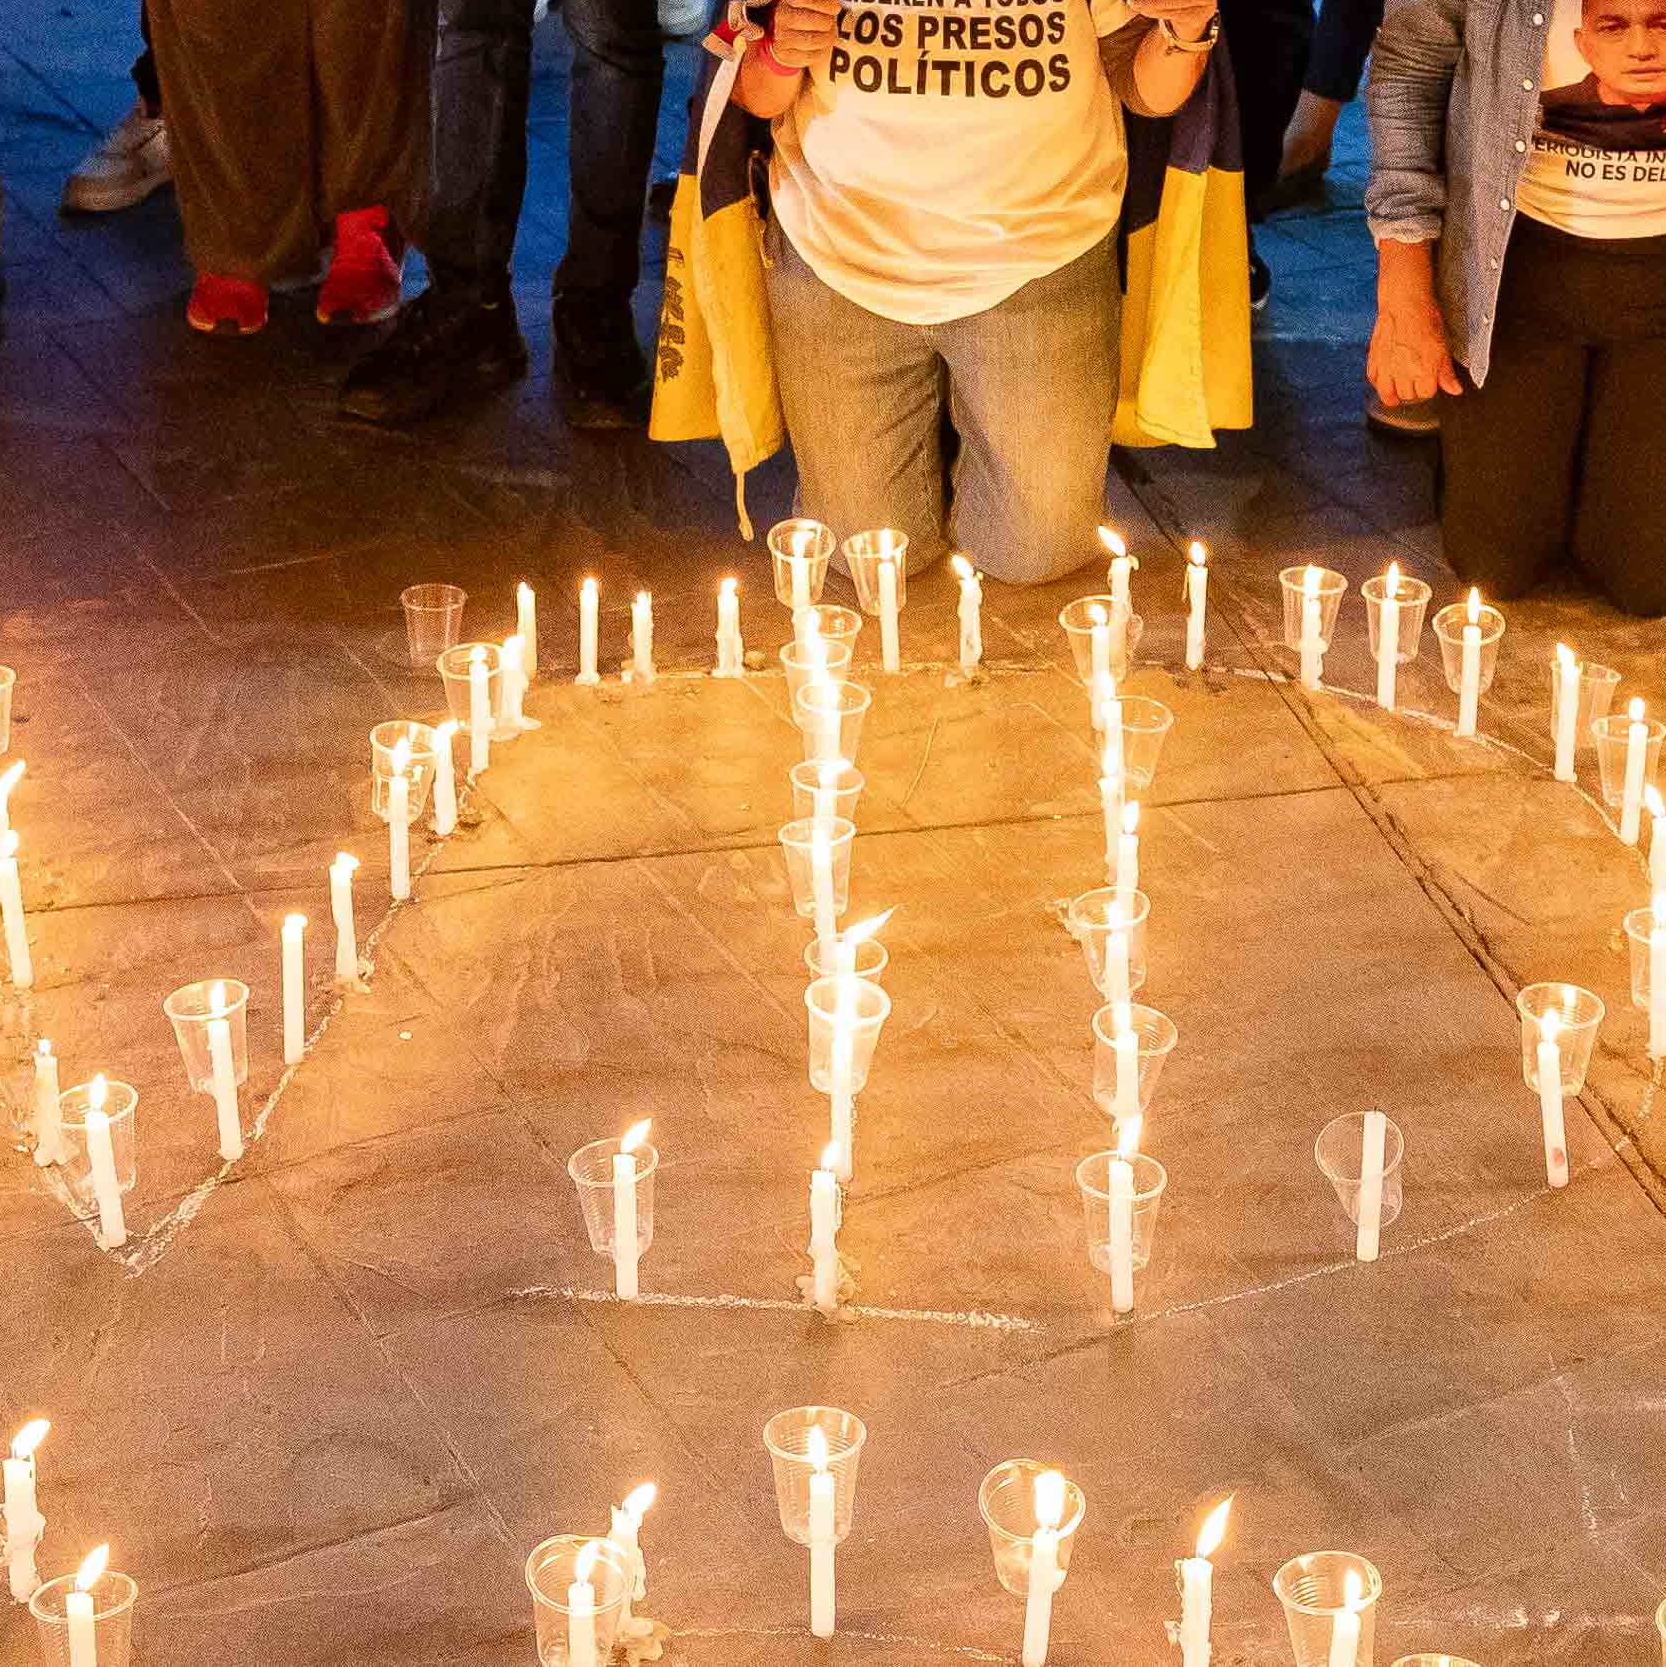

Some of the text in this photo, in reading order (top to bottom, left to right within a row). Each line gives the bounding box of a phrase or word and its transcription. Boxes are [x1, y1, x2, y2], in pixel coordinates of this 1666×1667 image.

[836, 10, 1066, 51] LOS PRESOS
[829, 50, 1071, 98] POLÍTICOS
[1532, 135, 1638, 163] ERIODISTA
[1565, 160, 1596, 178] NO
[1601, 164, 1627, 181] ES
